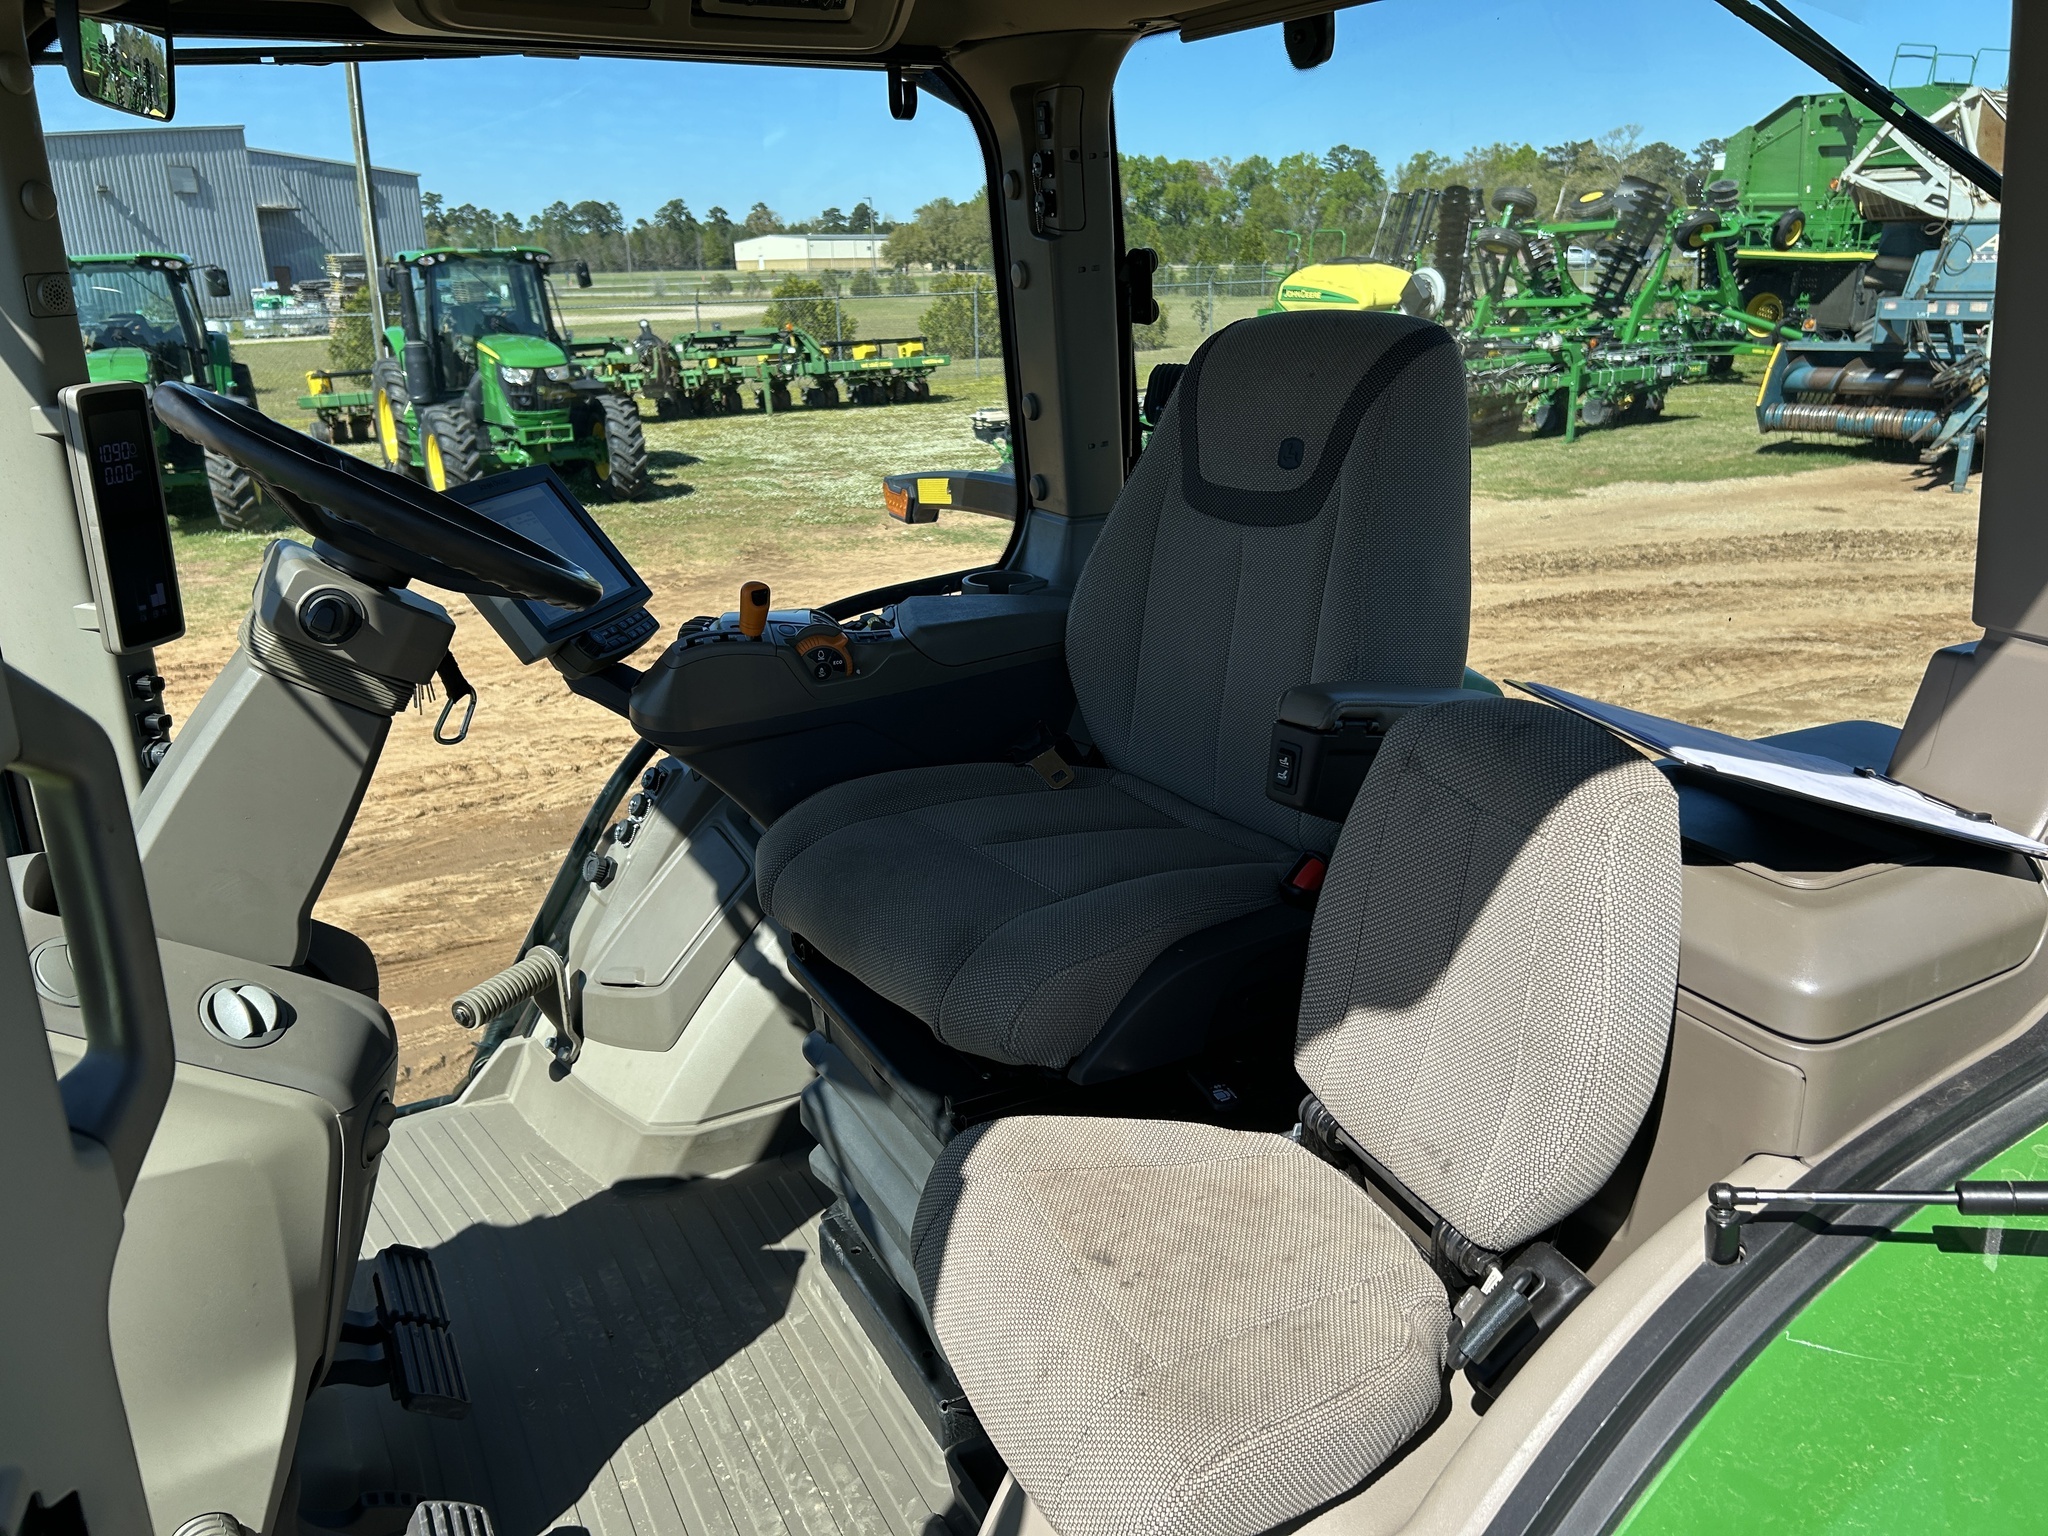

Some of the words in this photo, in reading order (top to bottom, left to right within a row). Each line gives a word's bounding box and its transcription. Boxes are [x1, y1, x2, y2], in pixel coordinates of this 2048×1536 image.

[1284, 290, 1302, 298] JOHN
[1301, 290, 1322, 299] DEERE
[99, 441, 130, 463] 1090
[104, 463, 134, 485] 0.00
